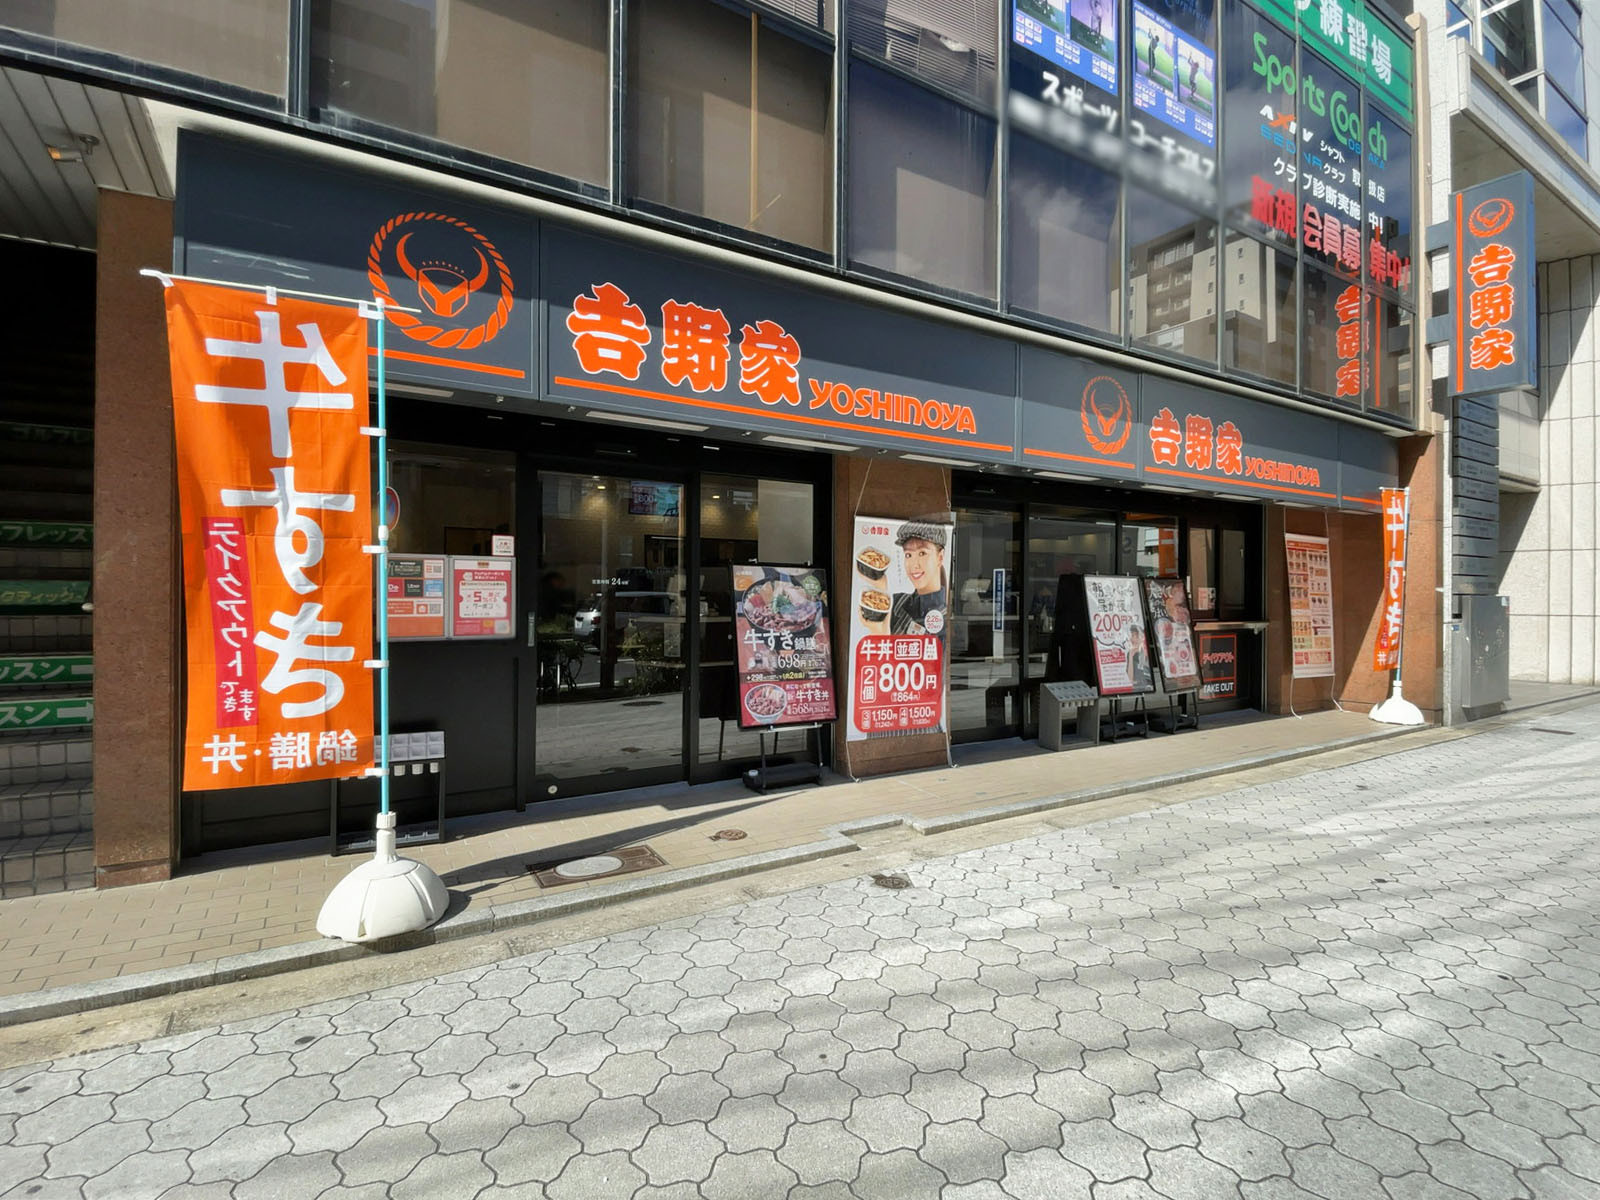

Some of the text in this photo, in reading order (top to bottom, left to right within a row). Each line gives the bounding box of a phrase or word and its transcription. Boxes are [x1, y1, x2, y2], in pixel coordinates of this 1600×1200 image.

[1253, 31, 1326, 117] Sports
[565, 281, 802, 407] 吉野家
[807, 378, 977, 435] YOSHINOYA
[1149, 406, 1243, 475] 吉野家
[1245, 456, 1321, 488] YOSHINOYA
[860, 639, 893, 661] 牛丼
[878, 661, 937, 692] 800円
[1220, 682, 1234, 691] OUT
